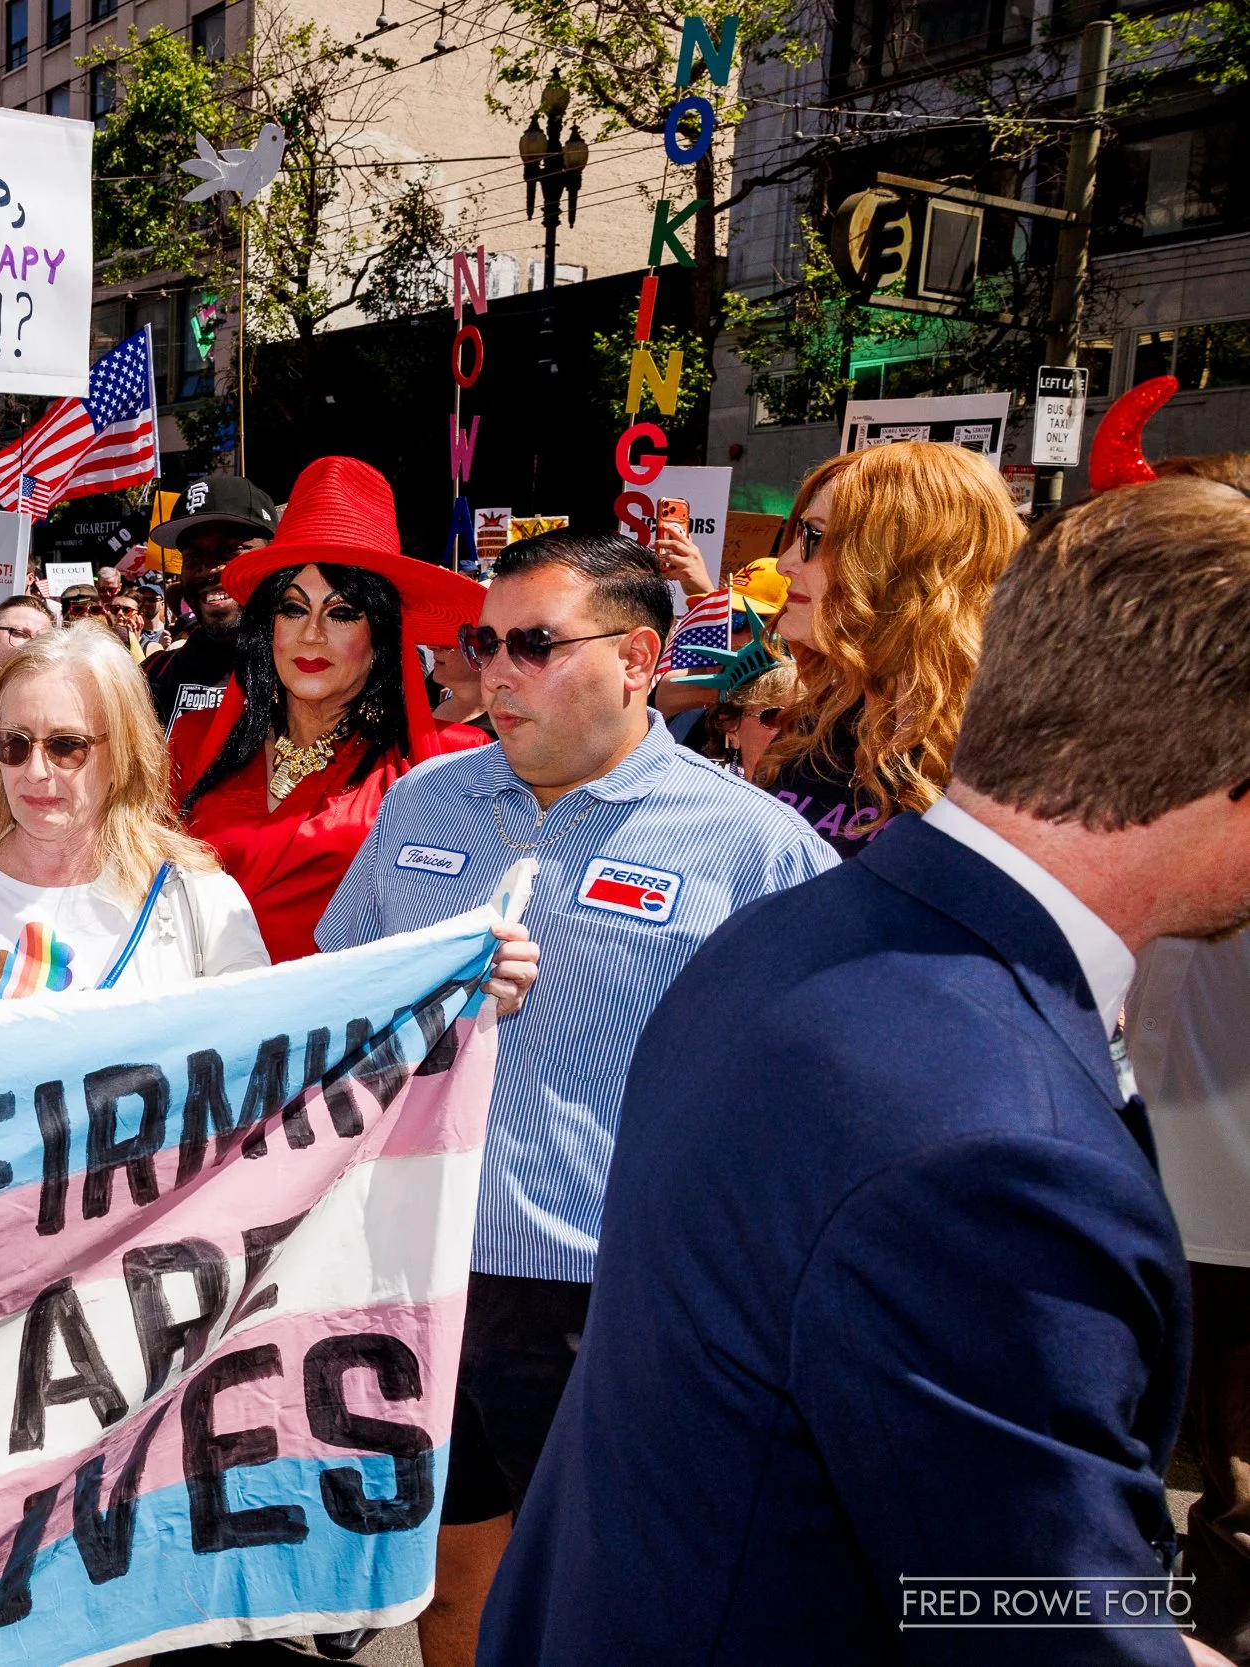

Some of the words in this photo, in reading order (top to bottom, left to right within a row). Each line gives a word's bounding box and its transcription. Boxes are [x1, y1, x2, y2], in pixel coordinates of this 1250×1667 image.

[665, 16, 739, 164] NO
[614, 200, 709, 547] KINGS
[1040, 378, 1061, 389] LEFT
[1062, 379, 1085, 390] LAE
[1047, 404, 1064, 414] BUS
[1050, 418, 1068, 429] TAXI
[1046, 432, 1069, 443] ONLY
[178, 690, 224, 710] People's
[598, 866, 672, 892] PERRA
